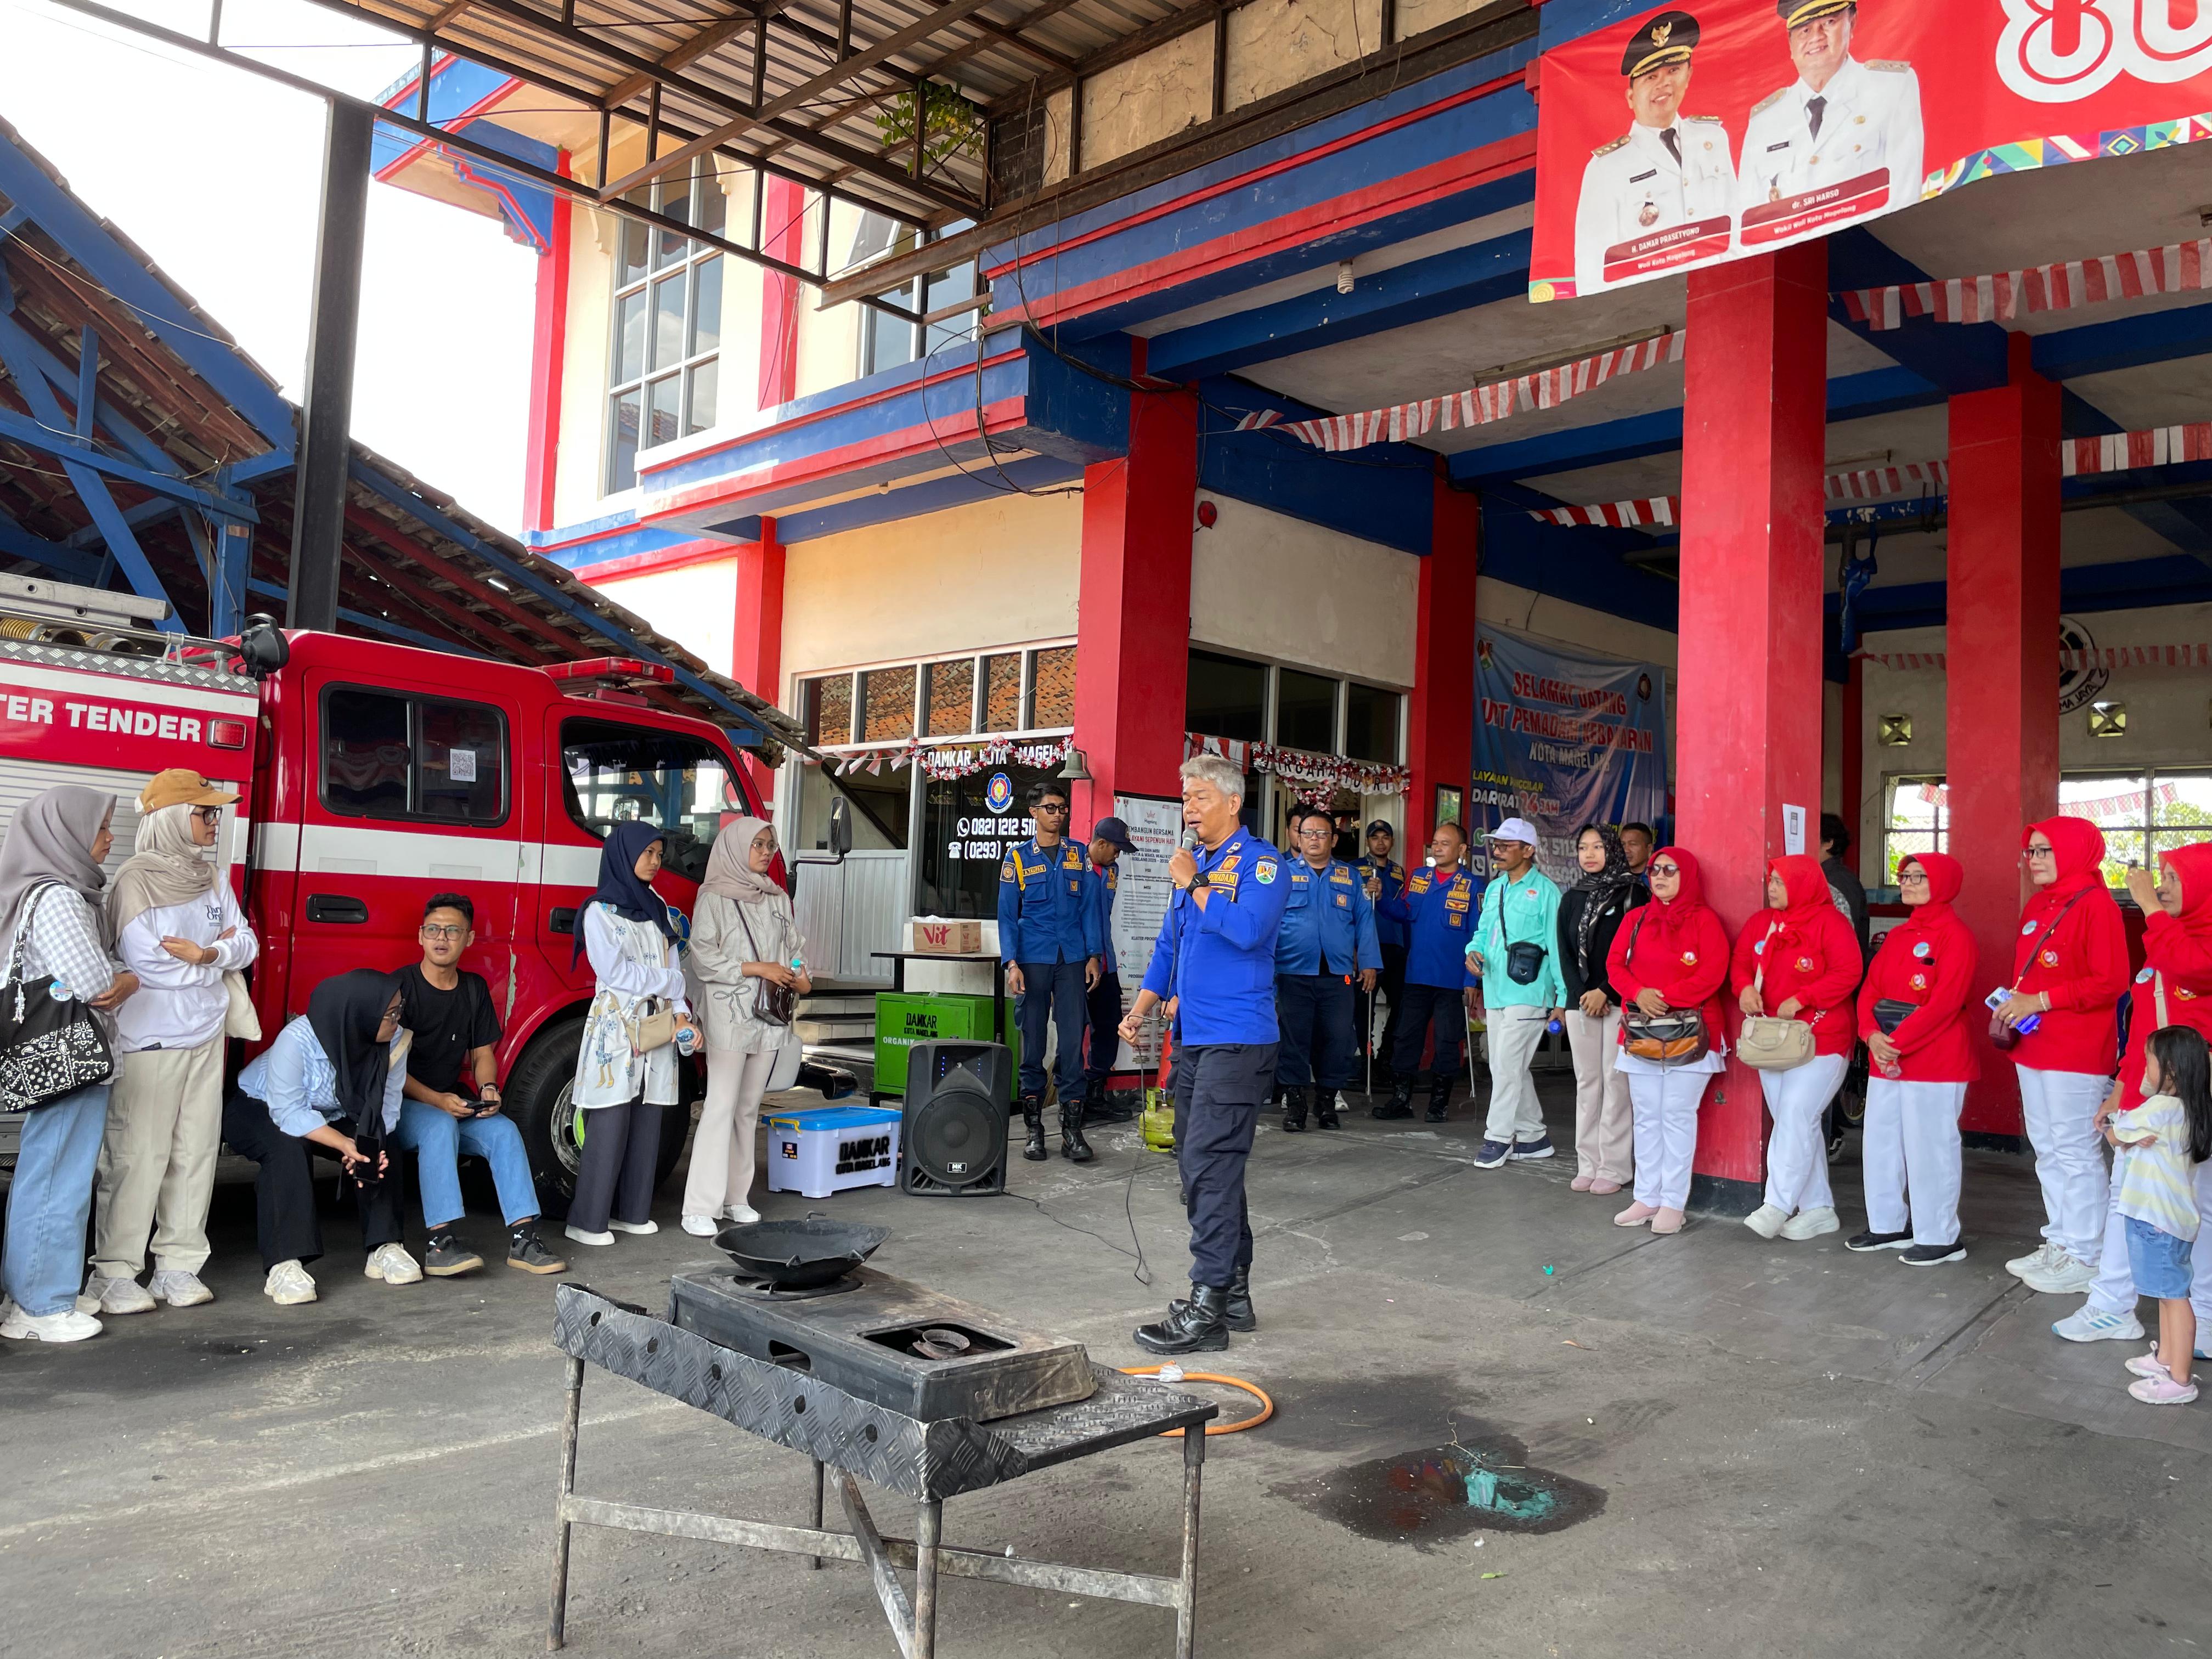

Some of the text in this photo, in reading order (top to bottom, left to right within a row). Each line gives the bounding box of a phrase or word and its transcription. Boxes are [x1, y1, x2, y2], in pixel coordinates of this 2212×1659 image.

[1792, 200, 1802, 209] dr.
[1803, 197, 1815, 206] SRI
[1774, 225, 1792, 234] Wakil
[1807, 214, 1822, 224] Kota
[1824, 204, 1857, 219] Magelang
[1639, 238, 1659, 251] DAMAR
[1660, 227, 1700, 245] PRASETYONO
[1652, 258, 1666, 266] Kota
[1666, 249, 1696, 263] Magelang
[1513, 670, 1627, 716] SELAMAT DATANG
[65, 702, 201, 742] TENDER
[1510, 706, 1579, 741] PEMADAM
[928, 749, 971, 768] DAMKAR
[1529, 742, 1555, 764] KOTA
[1539, 798, 1560, 816] JAM
[972, 818, 1037, 836] 0821 1212 511
[1153, 828, 1174, 836] BERSAMA
[1145, 836, 1165, 844] SEPENUH
[964, 840, 1001, 860] (0293)
[923, 924, 951, 945] Vit
[906, 1013, 937, 1029] DAMKAR
[883, 1036, 915, 1046] ORGANIK
[916, 1029, 938, 1038] MAGELANG
[839, 1136, 890, 1162] DAMKAR
